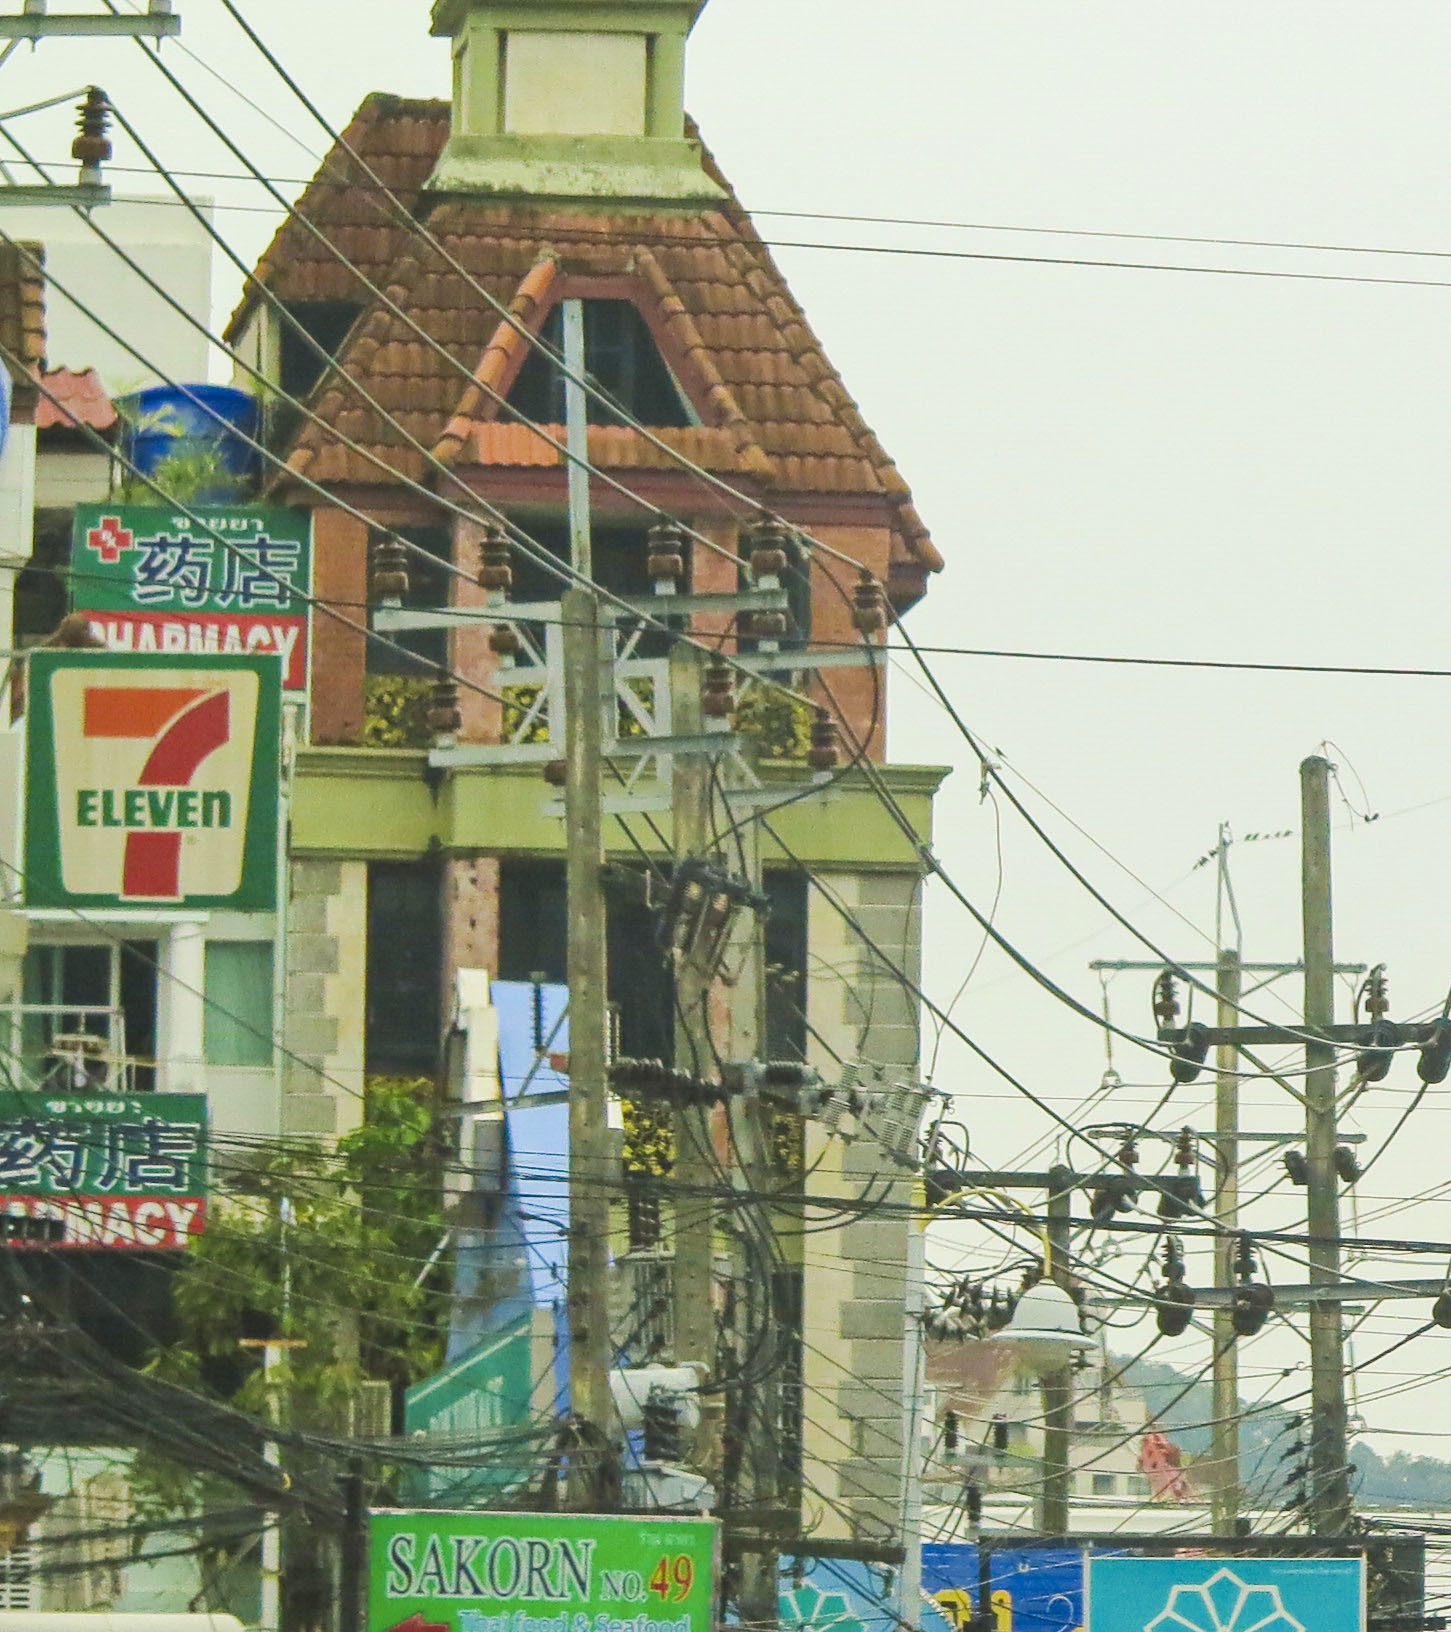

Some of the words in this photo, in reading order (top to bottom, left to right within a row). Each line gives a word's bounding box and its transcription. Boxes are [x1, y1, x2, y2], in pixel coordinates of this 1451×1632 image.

[133, 532, 300, 609] 药店
[388, 1534, 596, 1600] SAKORN
[602, 1570, 648, 1602] NO.
[649, 1554, 696, 1602] 49
